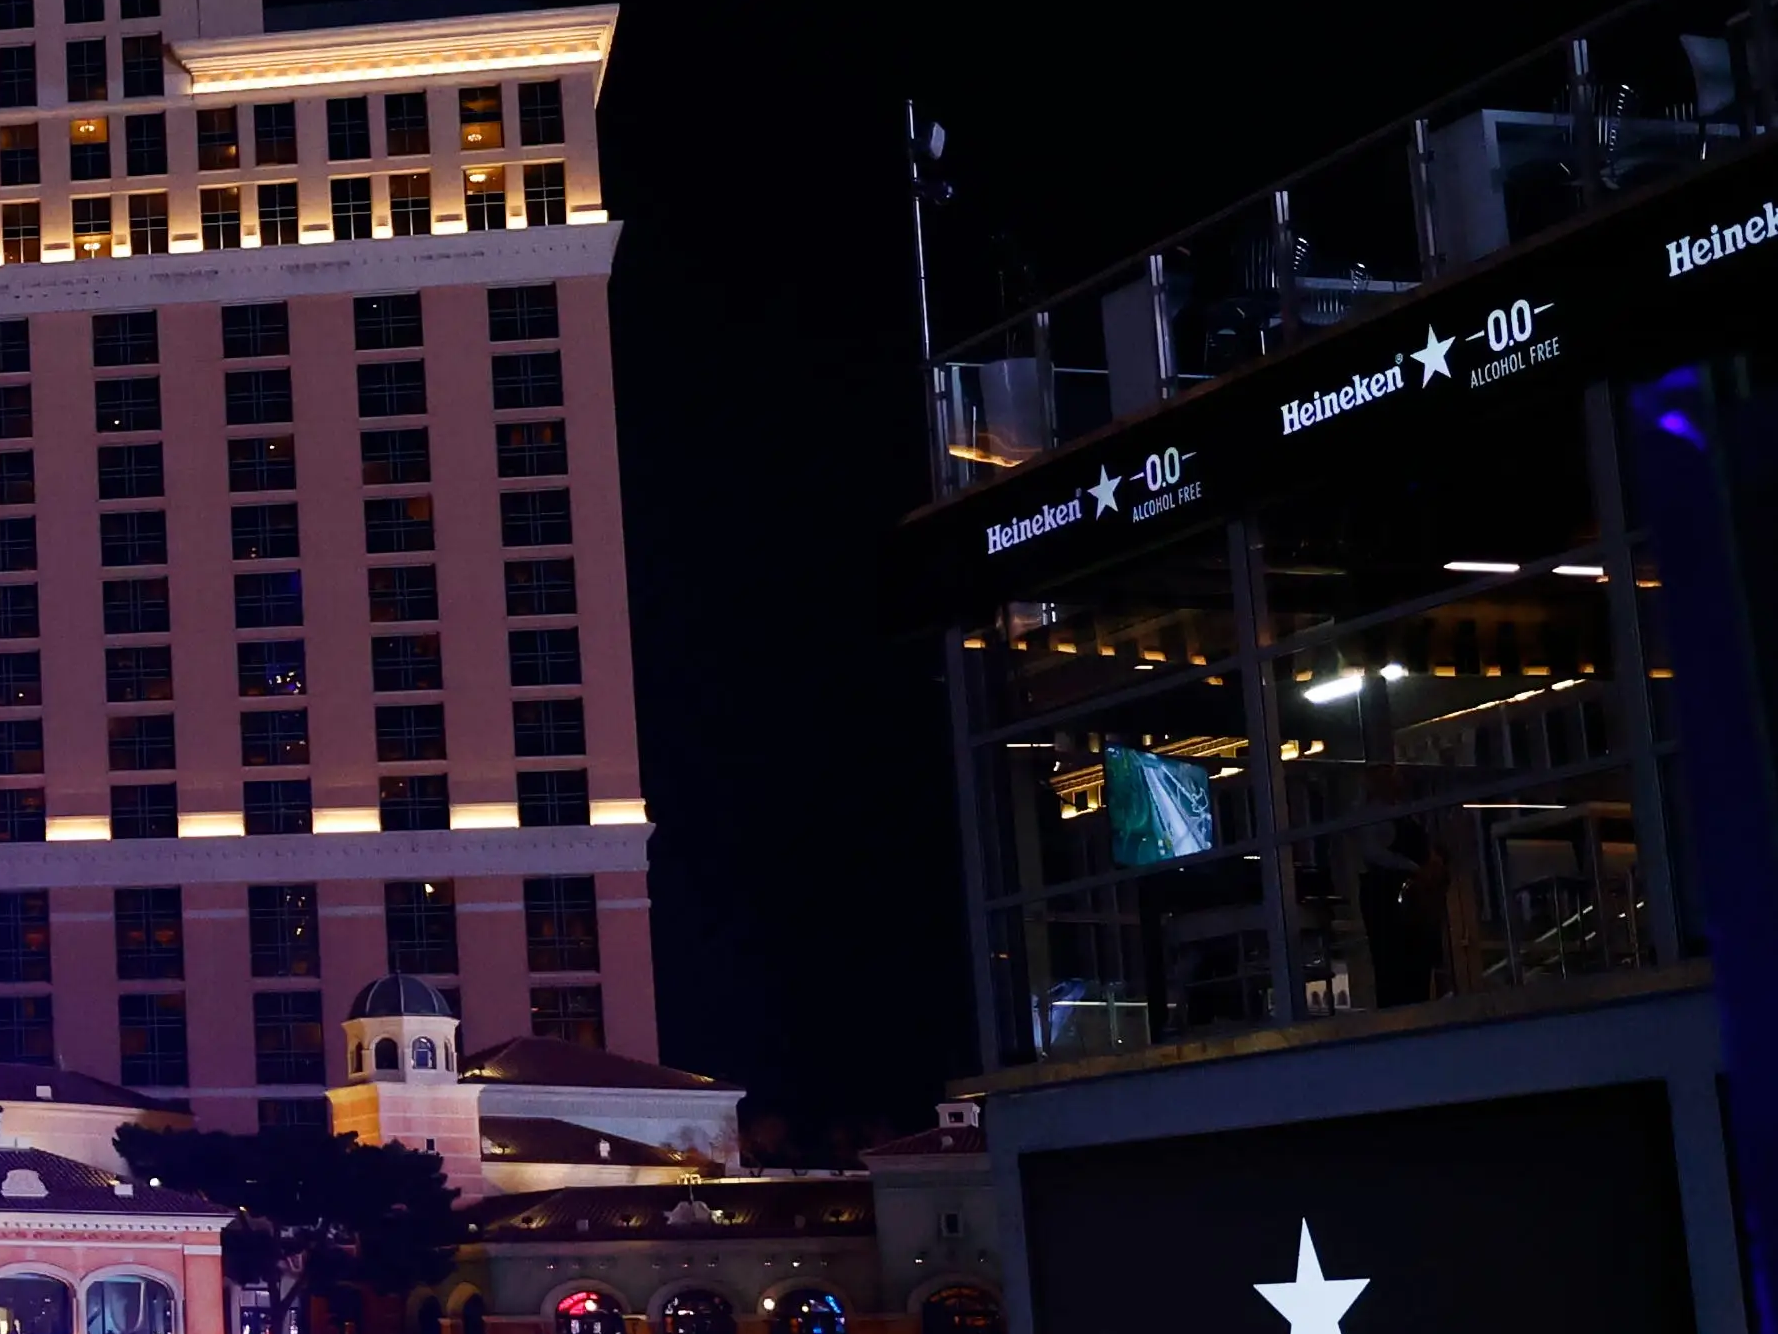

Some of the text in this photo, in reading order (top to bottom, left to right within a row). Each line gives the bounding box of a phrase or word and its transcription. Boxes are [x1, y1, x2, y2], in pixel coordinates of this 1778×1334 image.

[1470, 336, 1561, 389] ALCOHOL FREE
[1132, 481, 1202, 524] ALCOHOL FREE
